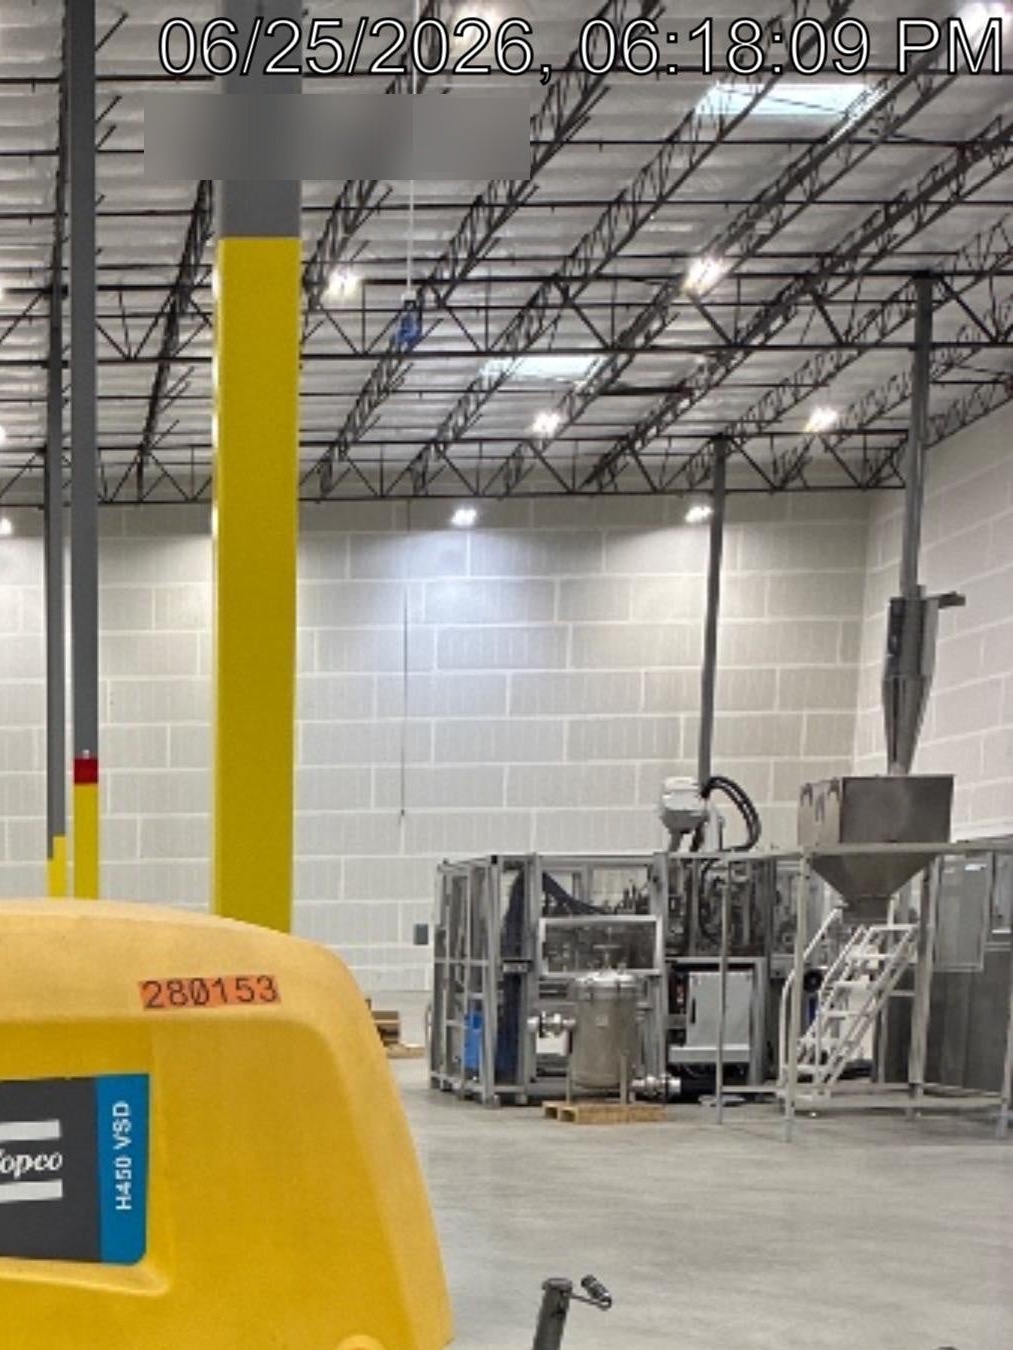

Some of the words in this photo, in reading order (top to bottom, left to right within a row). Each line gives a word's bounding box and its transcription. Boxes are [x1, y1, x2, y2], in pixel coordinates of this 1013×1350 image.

[142, 975, 278, 1008] 280153
[112, 1100, 132, 1149] VSD
[115, 1158, 133, 1210] H450
